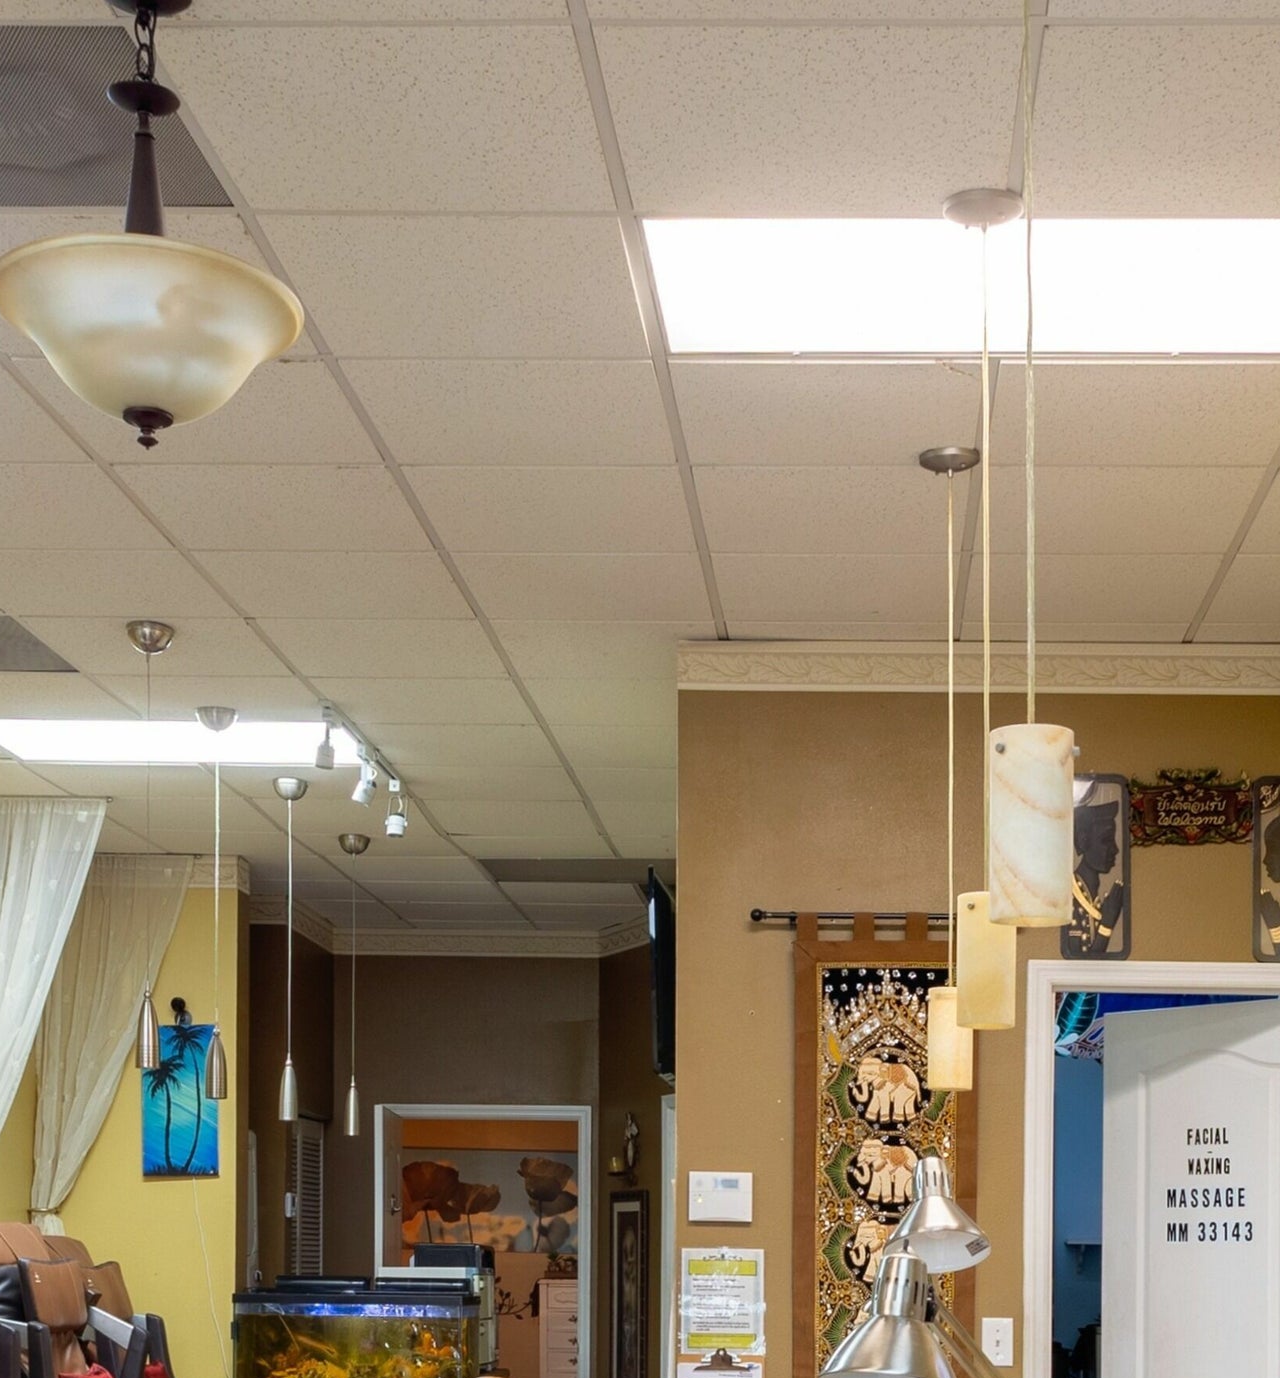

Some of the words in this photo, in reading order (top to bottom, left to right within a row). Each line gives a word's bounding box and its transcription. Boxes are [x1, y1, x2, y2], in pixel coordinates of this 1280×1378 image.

[1186, 1127, 1229, 1146] FACIAL
[1188, 1157, 1231, 1175] WAXING
[1166, 1188, 1246, 1209] MASSAGE
[1166, 1222, 1189, 1243] MM
[1197, 1221, 1254, 1242] 33143
